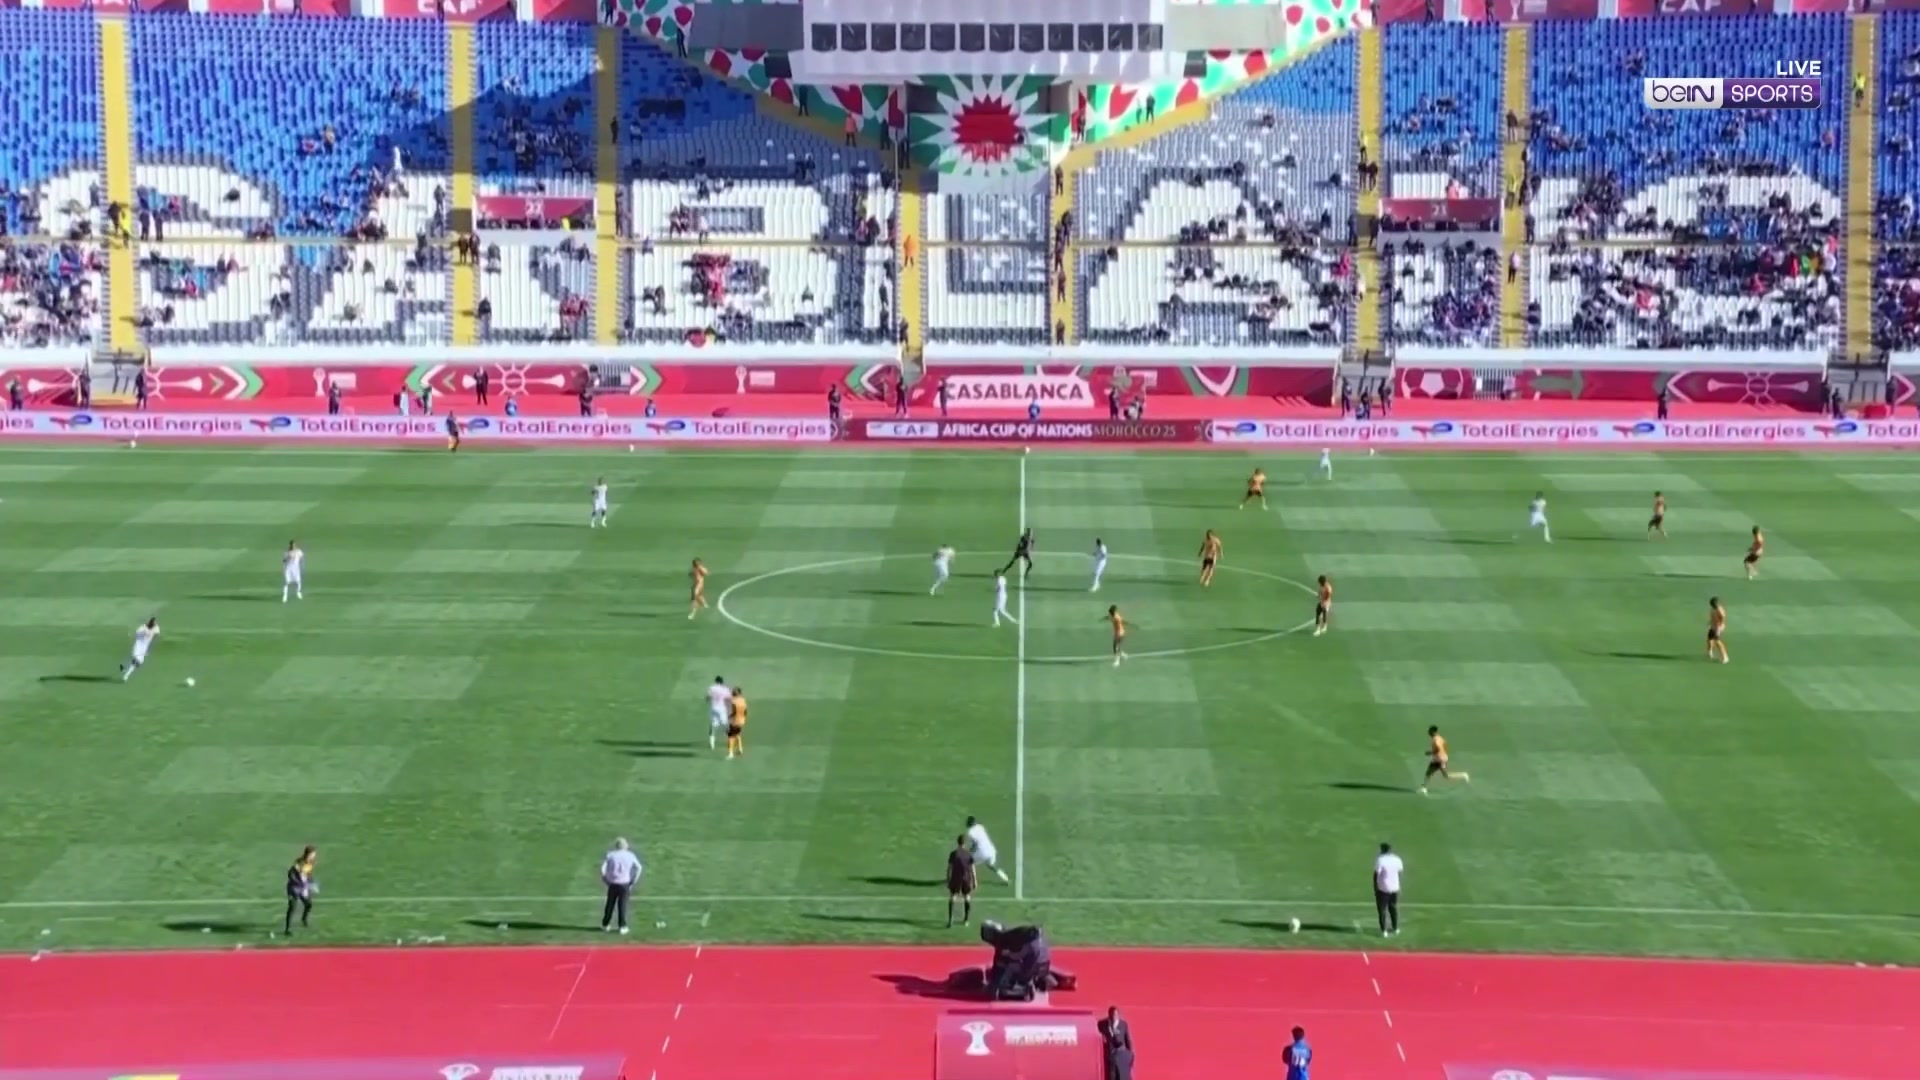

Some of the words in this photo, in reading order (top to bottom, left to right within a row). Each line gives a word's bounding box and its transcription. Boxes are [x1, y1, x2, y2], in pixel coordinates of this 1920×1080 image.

[945, 383, 1083, 400] CASABLANCA
[893, 424, 929, 437] CAF
[942, 423, 989, 437] AFRICA
[990, 423, 1016, 437] CUP
[1018, 423, 1035, 438] OF
[1037, 423, 1093, 437] NATIONS
[1094, 424, 1160, 438] MOROCCO
[1163, 424, 1176, 437] 25
